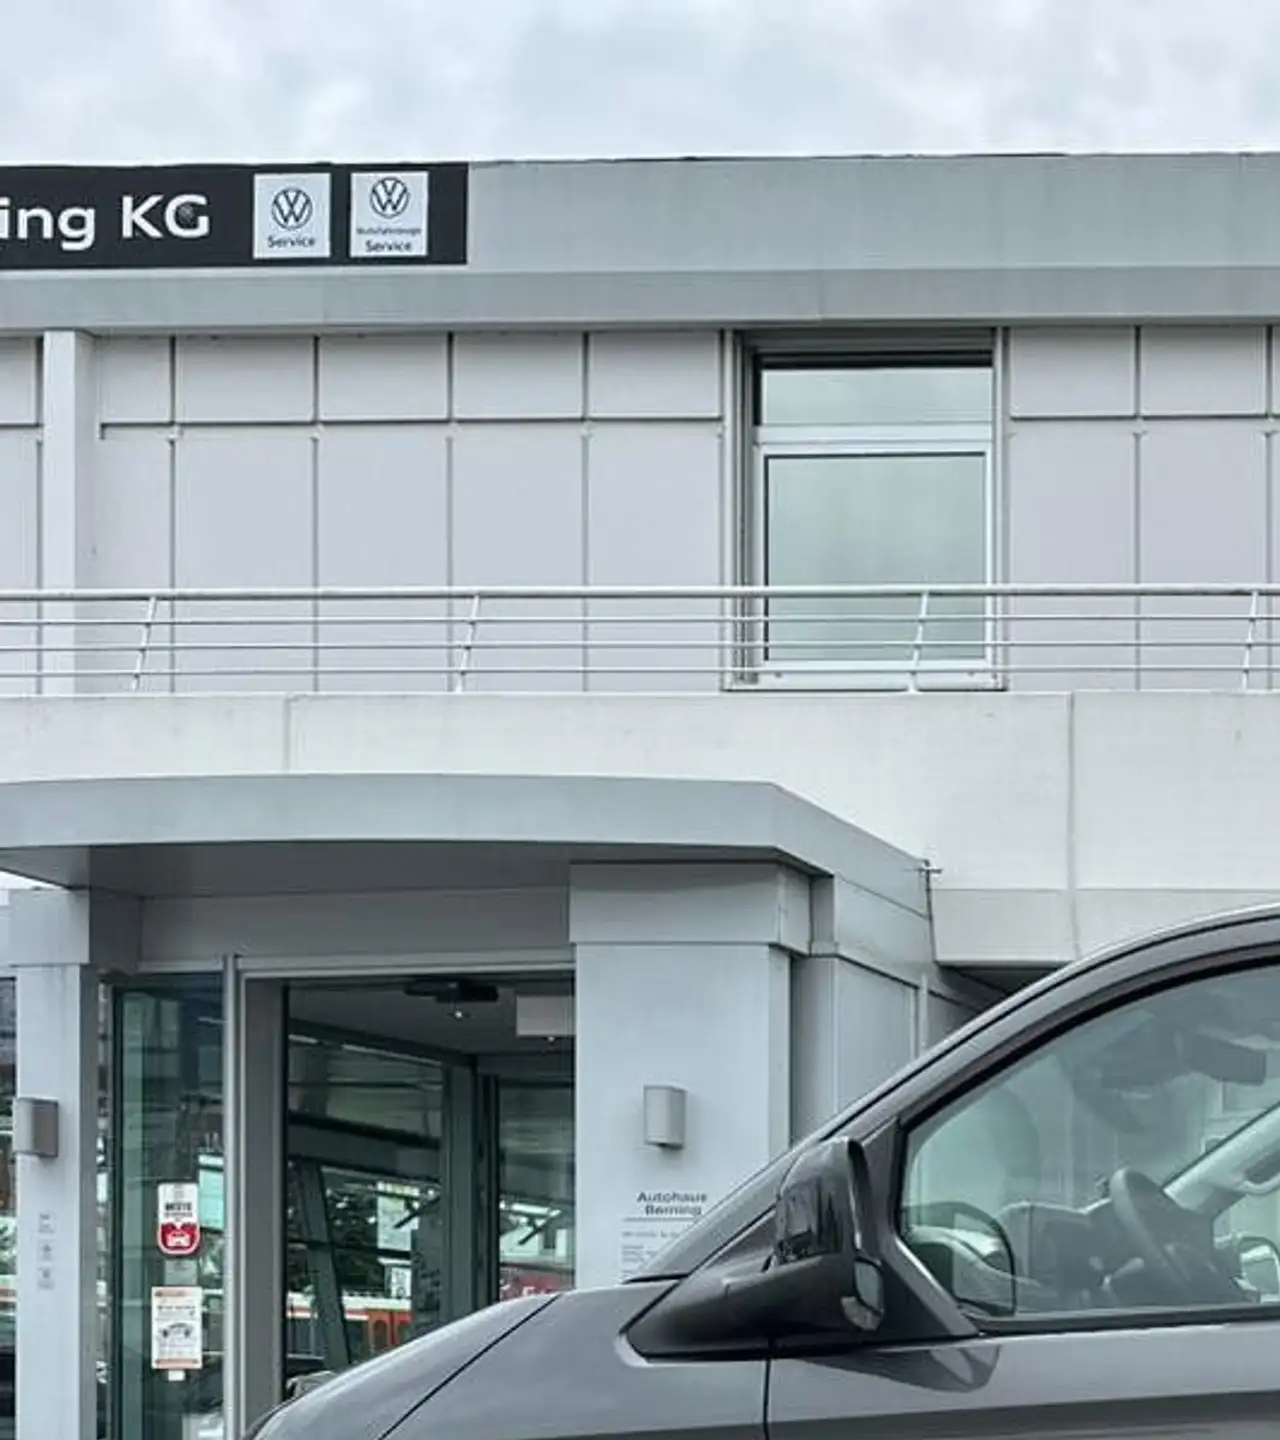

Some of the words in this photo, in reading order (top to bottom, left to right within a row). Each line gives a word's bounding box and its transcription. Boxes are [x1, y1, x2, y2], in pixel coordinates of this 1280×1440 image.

[121, 193, 210, 239] KG
[267, 235, 317, 249] Service
[364, 238, 413, 253] Service
